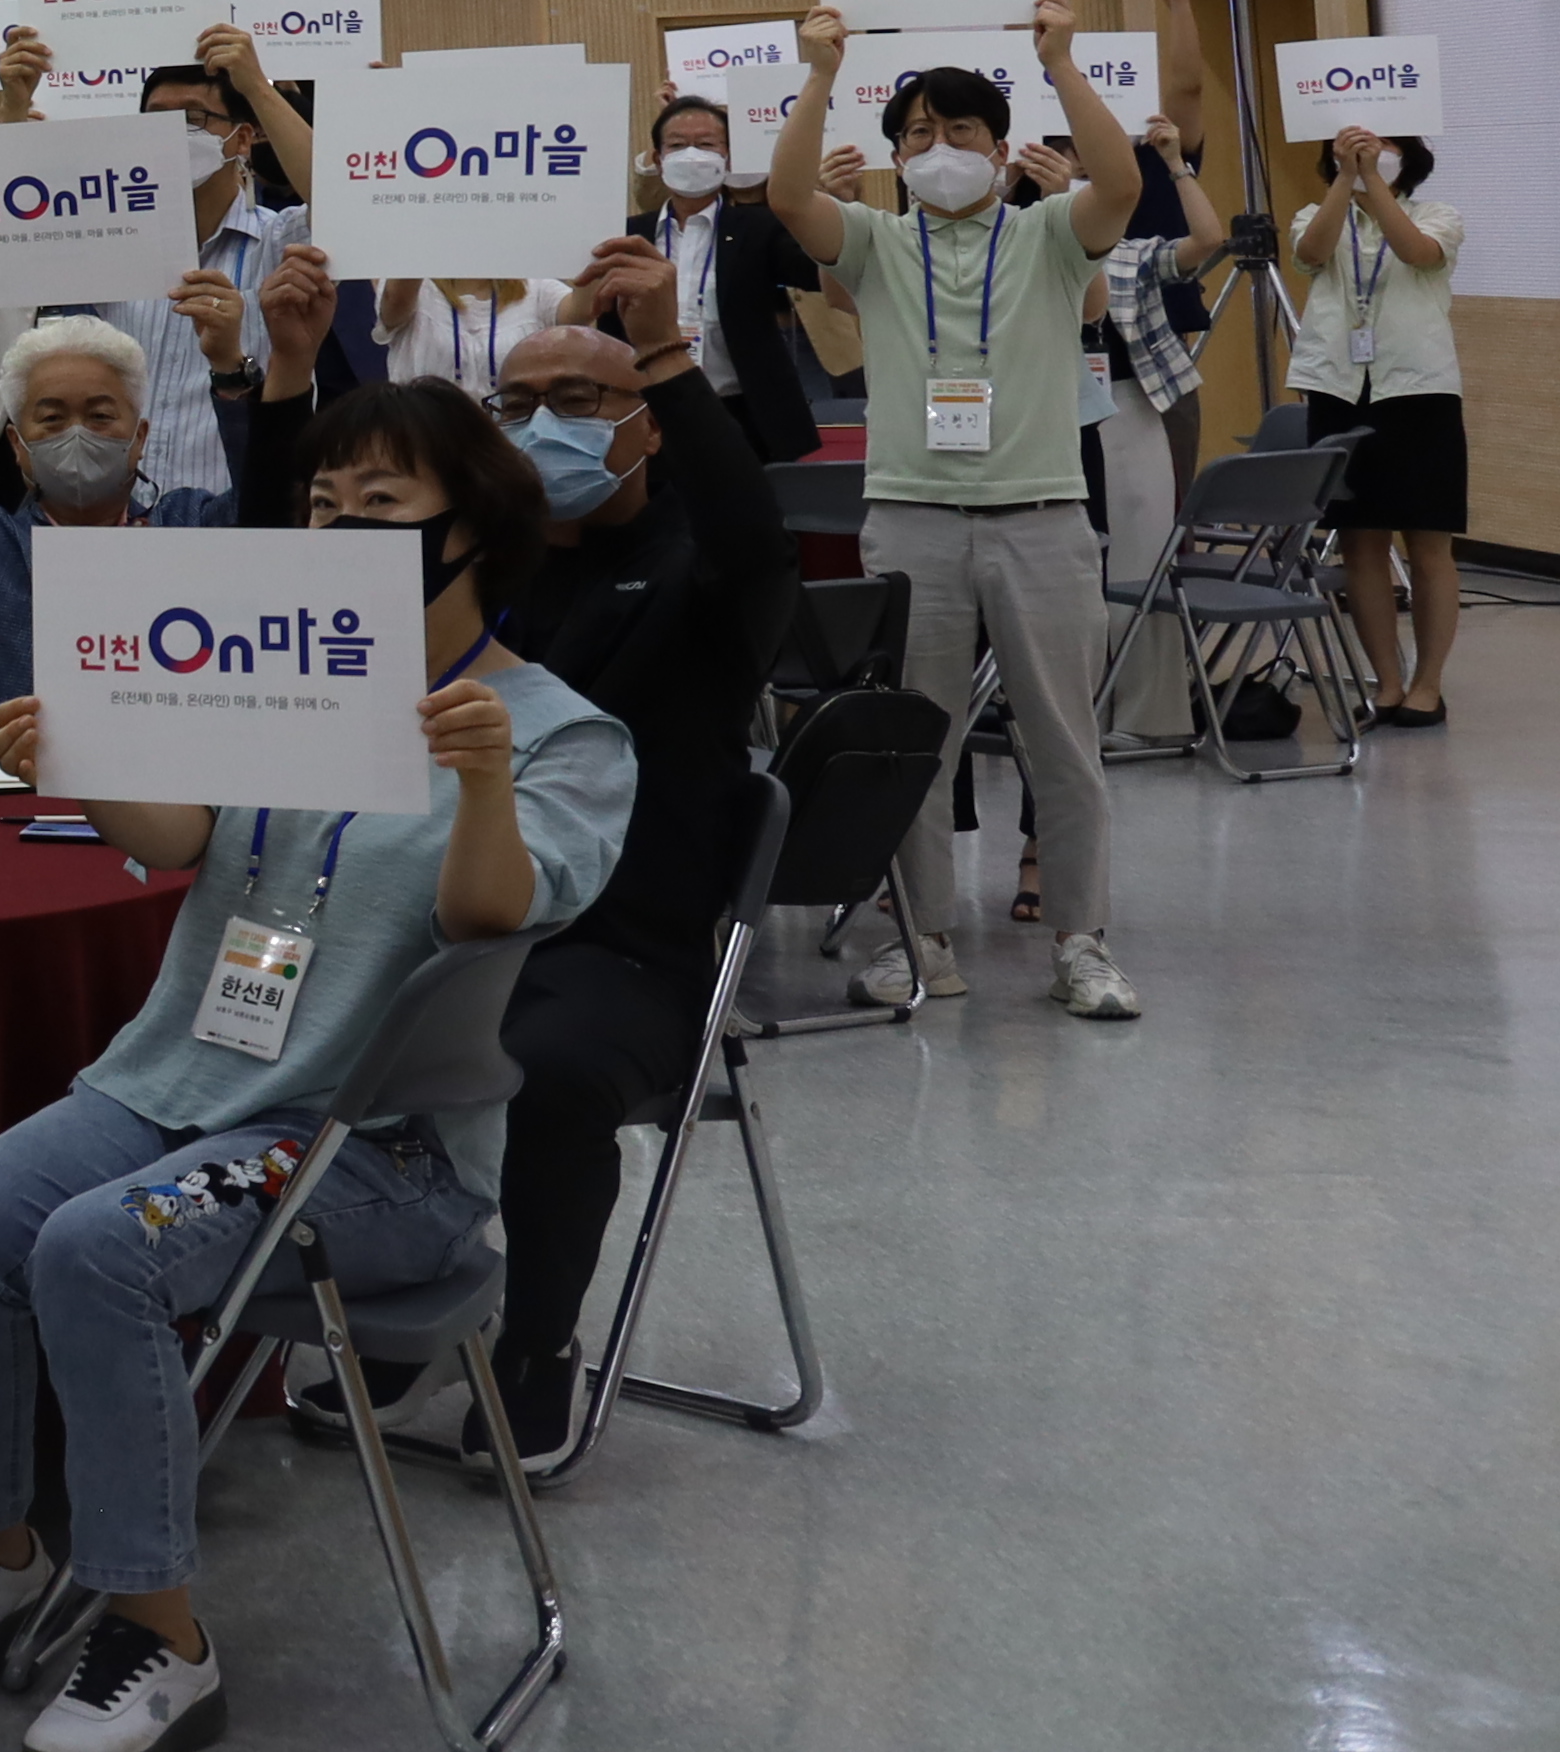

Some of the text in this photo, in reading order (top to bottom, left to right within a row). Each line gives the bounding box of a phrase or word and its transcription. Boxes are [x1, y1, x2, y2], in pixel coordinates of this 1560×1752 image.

[855, 85, 893, 104] 인천
[346, 150, 397, 181] 인천
[75, 634, 140, 672] 인천
[221, 975, 284, 1012] 한선희
